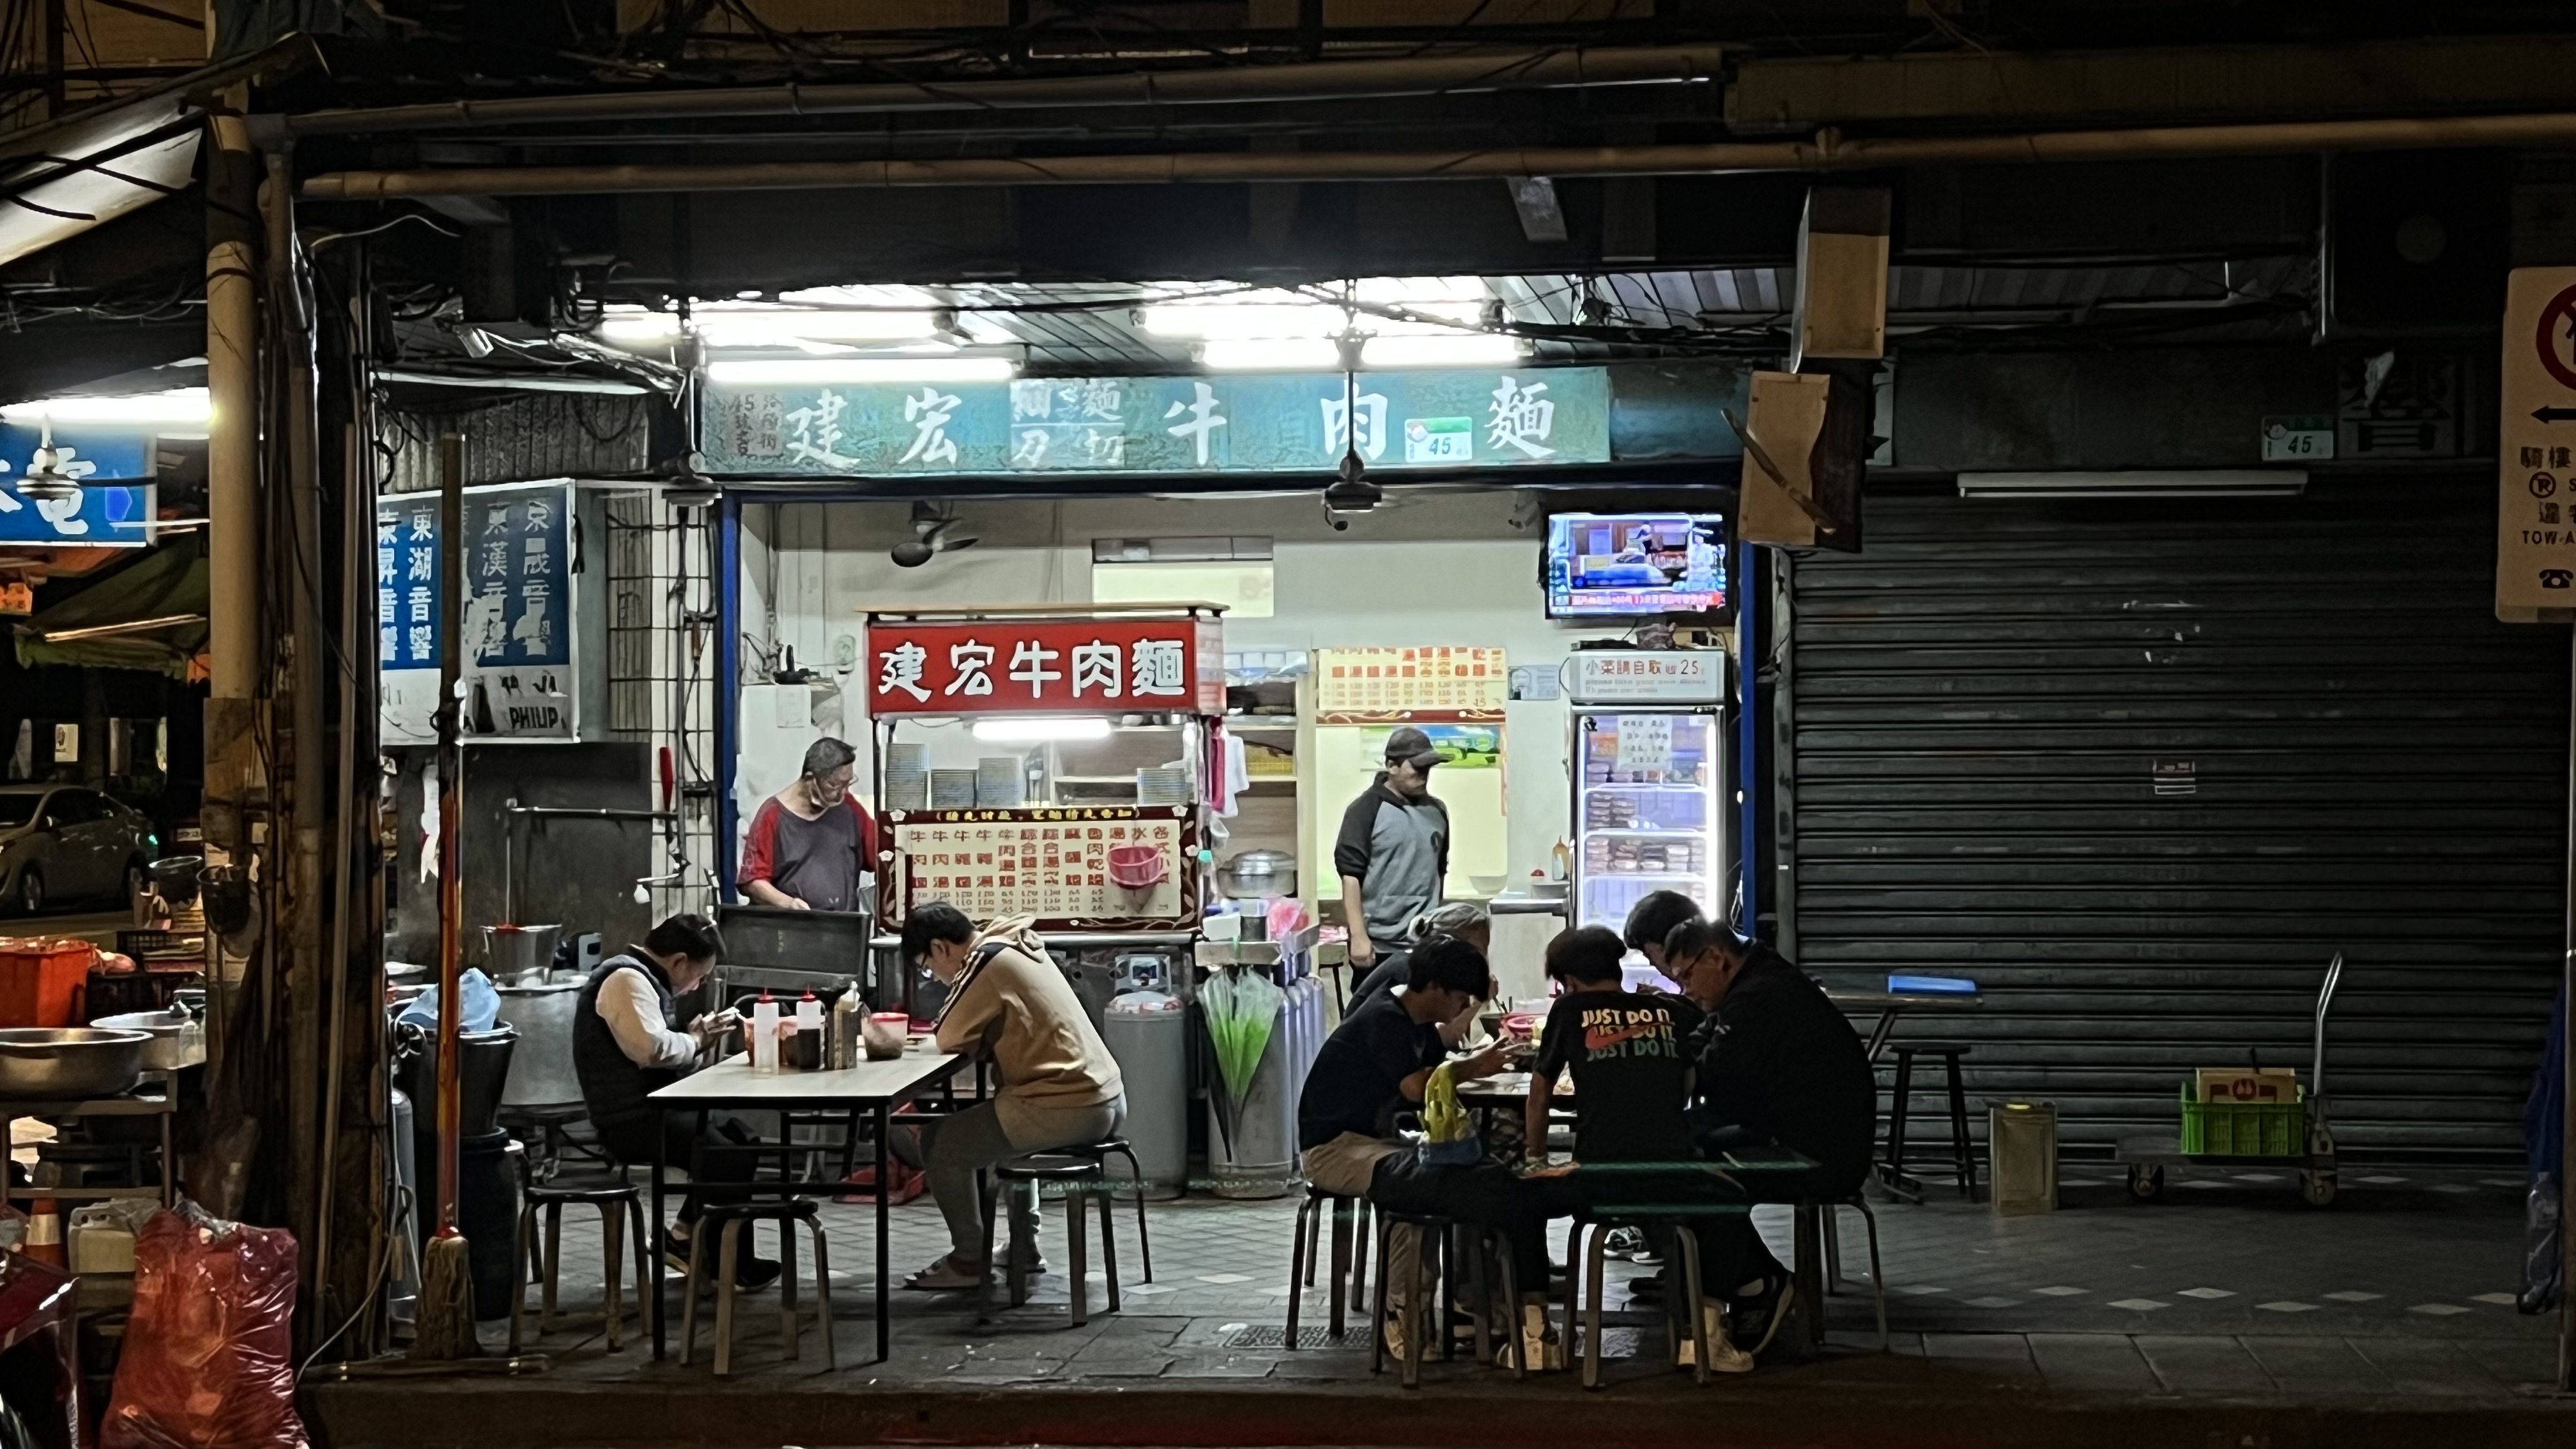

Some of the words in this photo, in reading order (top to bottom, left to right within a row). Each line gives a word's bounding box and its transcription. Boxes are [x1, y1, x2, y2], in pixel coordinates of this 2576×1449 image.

[1429, 436, 1452, 455] 45
[2288, 435, 2313, 454] 45
[408, 503, 434, 660] 東湖音響
[878, 638, 1185, 702] 建宏牛肉麵
[1581, 1009, 1621, 1027] JUST
[1626, 1009, 1653, 1024] DO
[1586, 1041, 1627, 1062] JUST
[1634, 1039, 1660, 1056] DO
